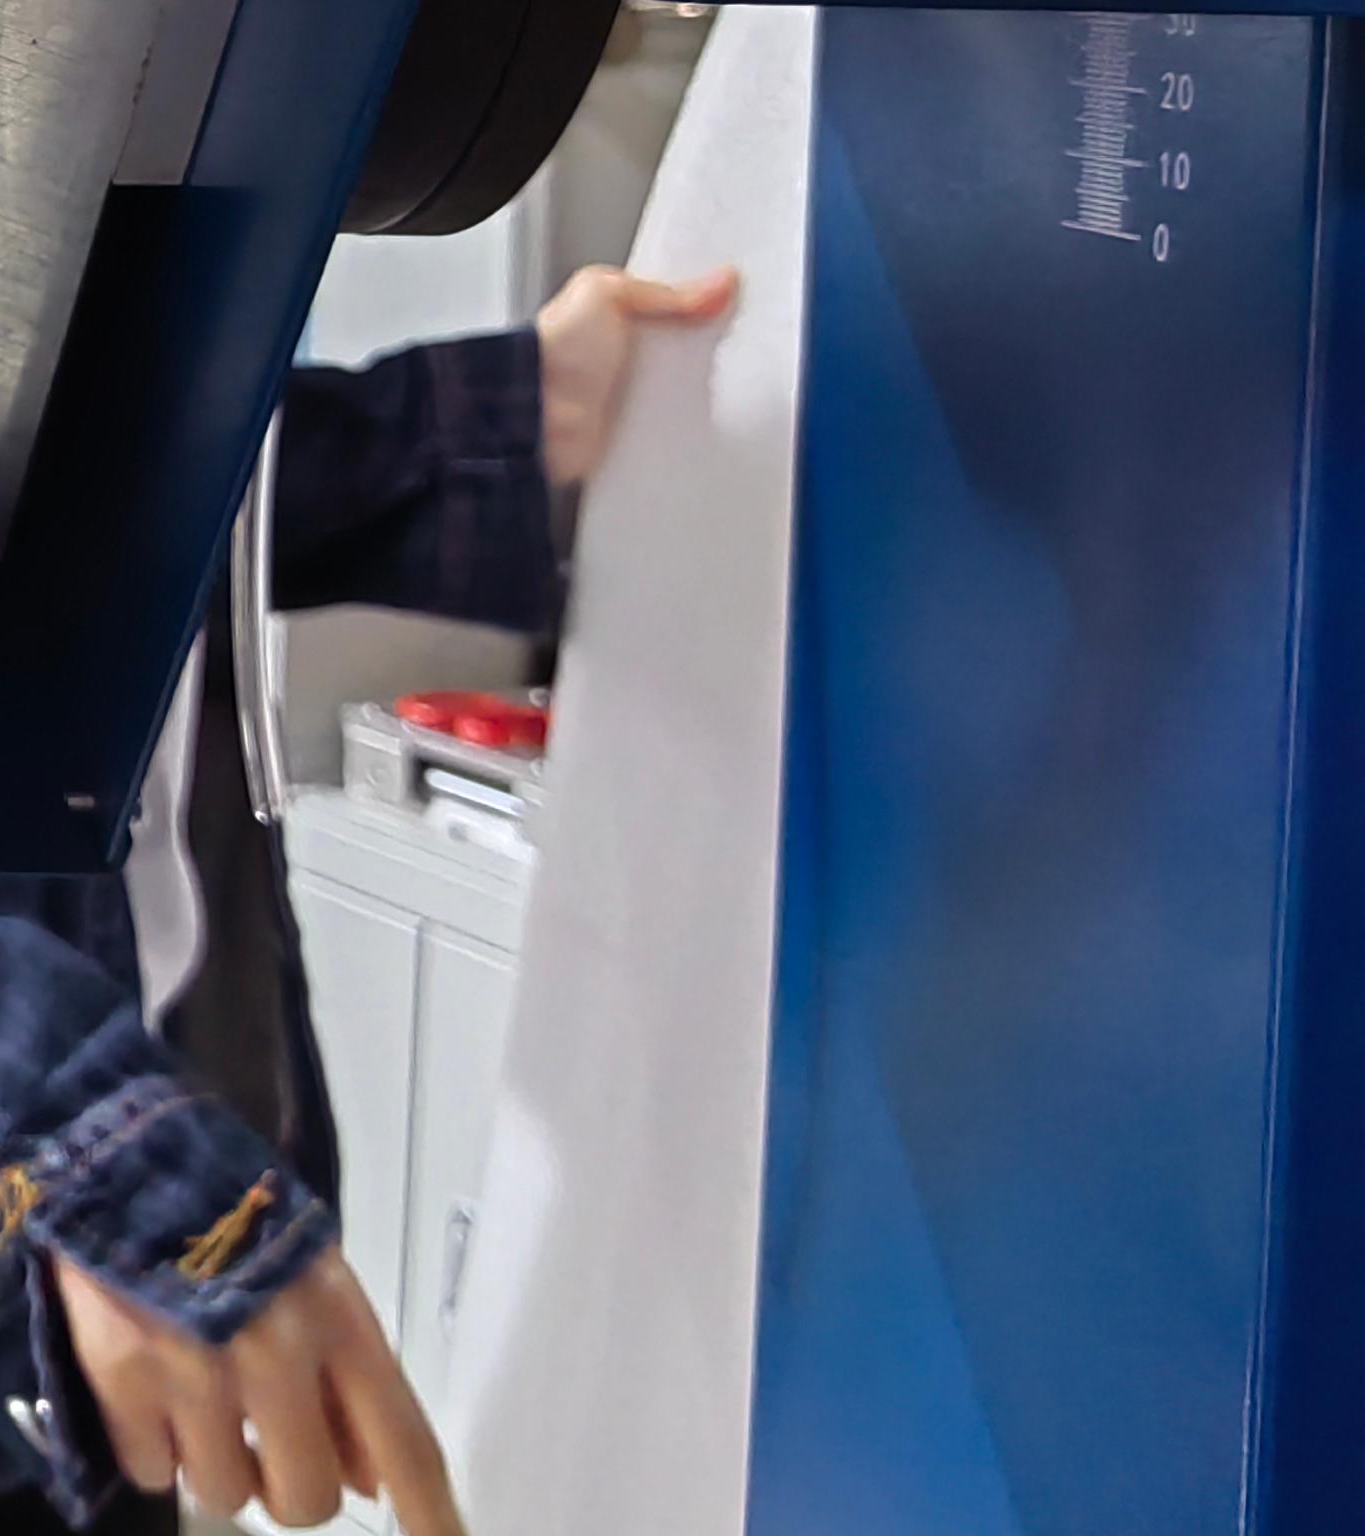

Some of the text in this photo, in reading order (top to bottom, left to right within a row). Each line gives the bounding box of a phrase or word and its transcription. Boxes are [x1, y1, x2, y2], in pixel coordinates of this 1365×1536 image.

[1160, 72, 1195, 112] 20
[1159, 152, 1191, 190] 10
[1152, 224, 1170, 262] 0
